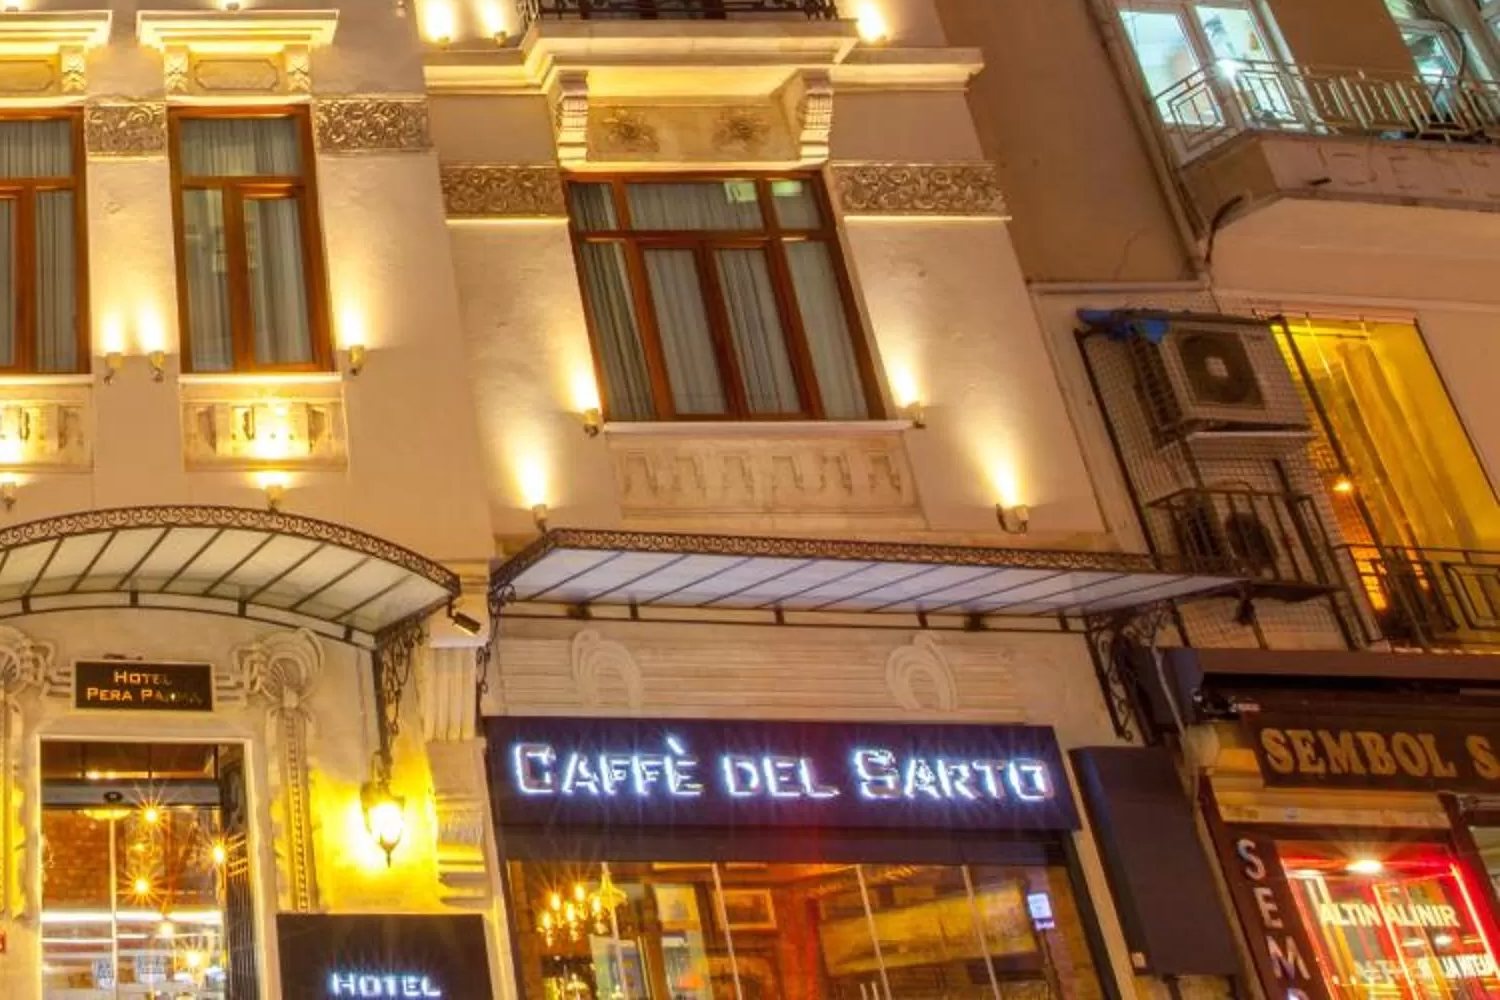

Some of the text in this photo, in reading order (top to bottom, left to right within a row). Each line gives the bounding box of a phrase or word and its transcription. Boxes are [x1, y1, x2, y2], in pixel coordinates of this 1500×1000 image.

[86, 687, 133, 701] PERA
[1260, 727, 1457, 778] SEMBOL
[512, 735, 1055, 801] CAFFÈ DEL SARTO
[1319, 902, 1381, 927] ALTIN
[333, 972, 442, 997] HOTEL
